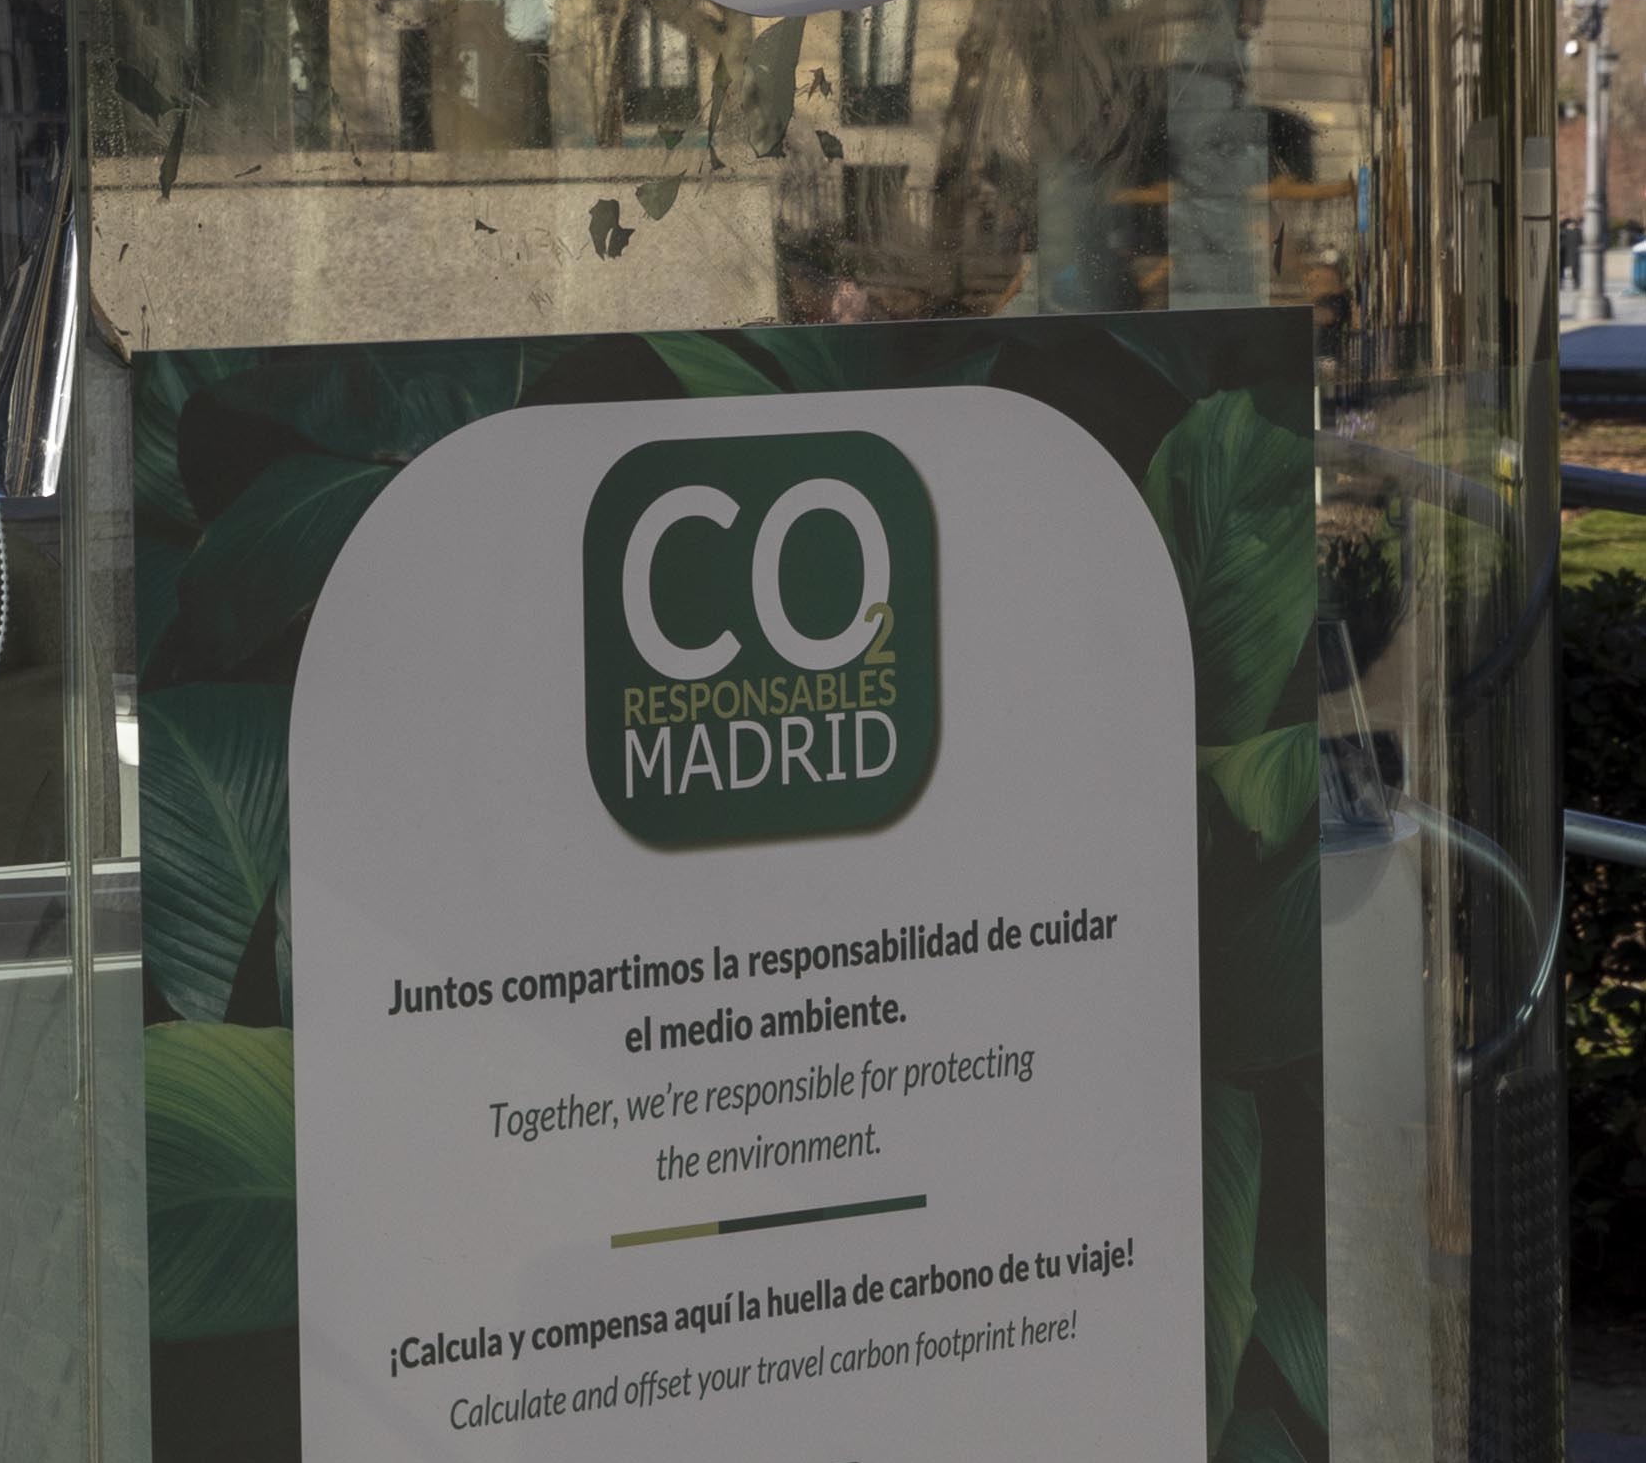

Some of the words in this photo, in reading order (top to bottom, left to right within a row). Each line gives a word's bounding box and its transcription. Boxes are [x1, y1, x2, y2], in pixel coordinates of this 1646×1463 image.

[623, 669, 896, 727] RESPONSABLES
[625, 710, 897, 798] MADRID
[389, 977, 493, 1015] Juntos
[502, 954, 704, 1003] compartimos
[714, 946, 738, 980] la
[749, 919, 978, 979] responsabilidad
[988, 917, 1021, 951] de
[1030, 908, 1117, 947] cuidar
[625, 1016, 651, 1053] el
[661, 1007, 752, 1049] medio
[760, 995, 906, 1038] ambiente.
[490, 1094, 618, 1142] Together,
[627, 1082, 698, 1121] we’re
[706, 1063, 854, 1115] responsible
[861, 1060, 898, 1099] for
[904, 1044, 1035, 1096] protecting
[657, 1145, 699, 1181] the
[707, 1124, 880, 1174] environment.
[391, 1327, 502, 1377] ¡Calcula
[509, 1330, 525, 1360] y
[532, 1311, 667, 1350] compensa
[675, 1293, 733, 1333] aquí
[739, 1291, 760, 1321] la
[768, 1279, 846, 1317] huella
[853, 1274, 884, 1305] de
[890, 1264, 993, 1299] carbono
[999, 1254, 1029, 1284] de
[1035, 1253, 1060, 1279] tu
[1067, 1238, 1133, 1277] viaje!
[451, 1388, 566, 1430] Calculate
[572, 1375, 618, 1412] and
[625, 1368, 692, 1407] offset
[698, 1365, 751, 1400] your
[757, 1345, 824, 1385] travel
[830, 1339, 909, 1374] carbon
[916, 1321, 1015, 1366] footprint
[1021, 1310, 1076, 1346] here!
